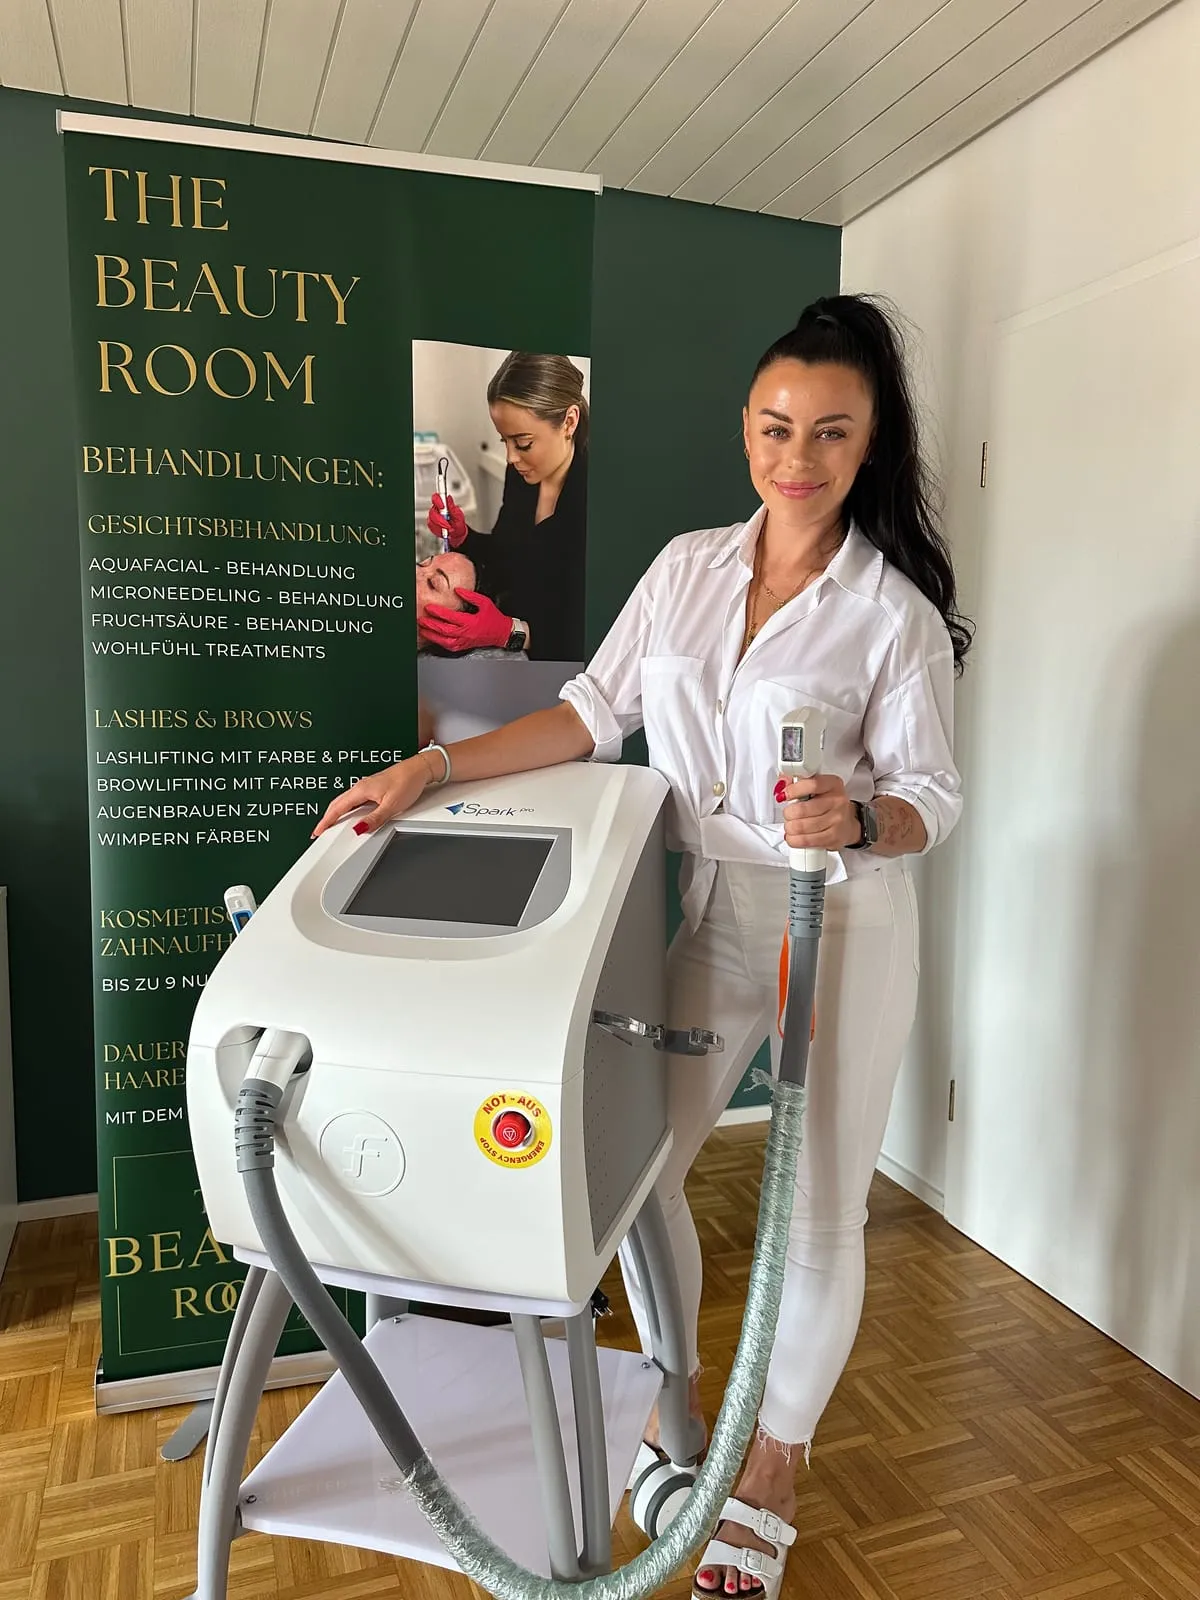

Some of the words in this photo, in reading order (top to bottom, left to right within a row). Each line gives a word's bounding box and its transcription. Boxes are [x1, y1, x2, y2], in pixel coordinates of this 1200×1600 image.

[88, 166, 229, 231] THE
[94, 254, 361, 325] BEAUTY
[97, 340, 316, 405] ROOM
[82, 445, 384, 489] BEHANDLUNGEN:
[87, 513, 387, 546] GESICHTSBEHANDLUNG:
[88, 557, 209, 574] AQUAFACIAL
[226, 560, 356, 580] BEHANDLUNG
[90, 585, 261, 604] MICRONEEDELING
[278, 591, 405, 609] BEHANDLUNG
[91, 612, 229, 630] FRUCHTSÄURE
[246, 616, 374, 634] BEHANDLUNG
[91, 639, 201, 656] WOHLFÜHL
[205, 642, 326, 660] TREATMENTS
[95, 709, 188, 729] LASHES
[194, 709, 217, 729] &
[224, 710, 313, 730] BROWS
[96, 750, 214, 765] LASHLIFTING
[220, 750, 252, 764] MIT
[258, 750, 317, 764] FARBE
[321, 750, 333, 763] &
[338, 750, 402, 763] PFLEGE
[96, 777, 227, 793] BROWLIFTING
[233, 777, 265, 791] MIT
[270, 776, 328, 790] FARBE
[333, 776, 345, 789] &
[96, 803, 241, 820] AUGENBRAUEN
[246, 802, 319, 817] ZUPFEN
[463, 803, 517, 817] Spark
[97, 831, 189, 847] WIMPERN
[196, 828, 270, 844] FÄRBEN
[100, 905, 232, 929] KOSMETIS
[102, 976, 130, 992] BIS
[134, 976, 159, 991] ZU
[164, 976, 176, 990] 9
[103, 1040, 186, 1063] DAUER
[104, 1067, 186, 1090] HAARE
[105, 1111, 137, 1125] MIT
[142, 1106, 183, 1123] DEM
[479, 1137, 498, 1155] STOP
[497, 1140, 545, 1164] EMERGENCY
